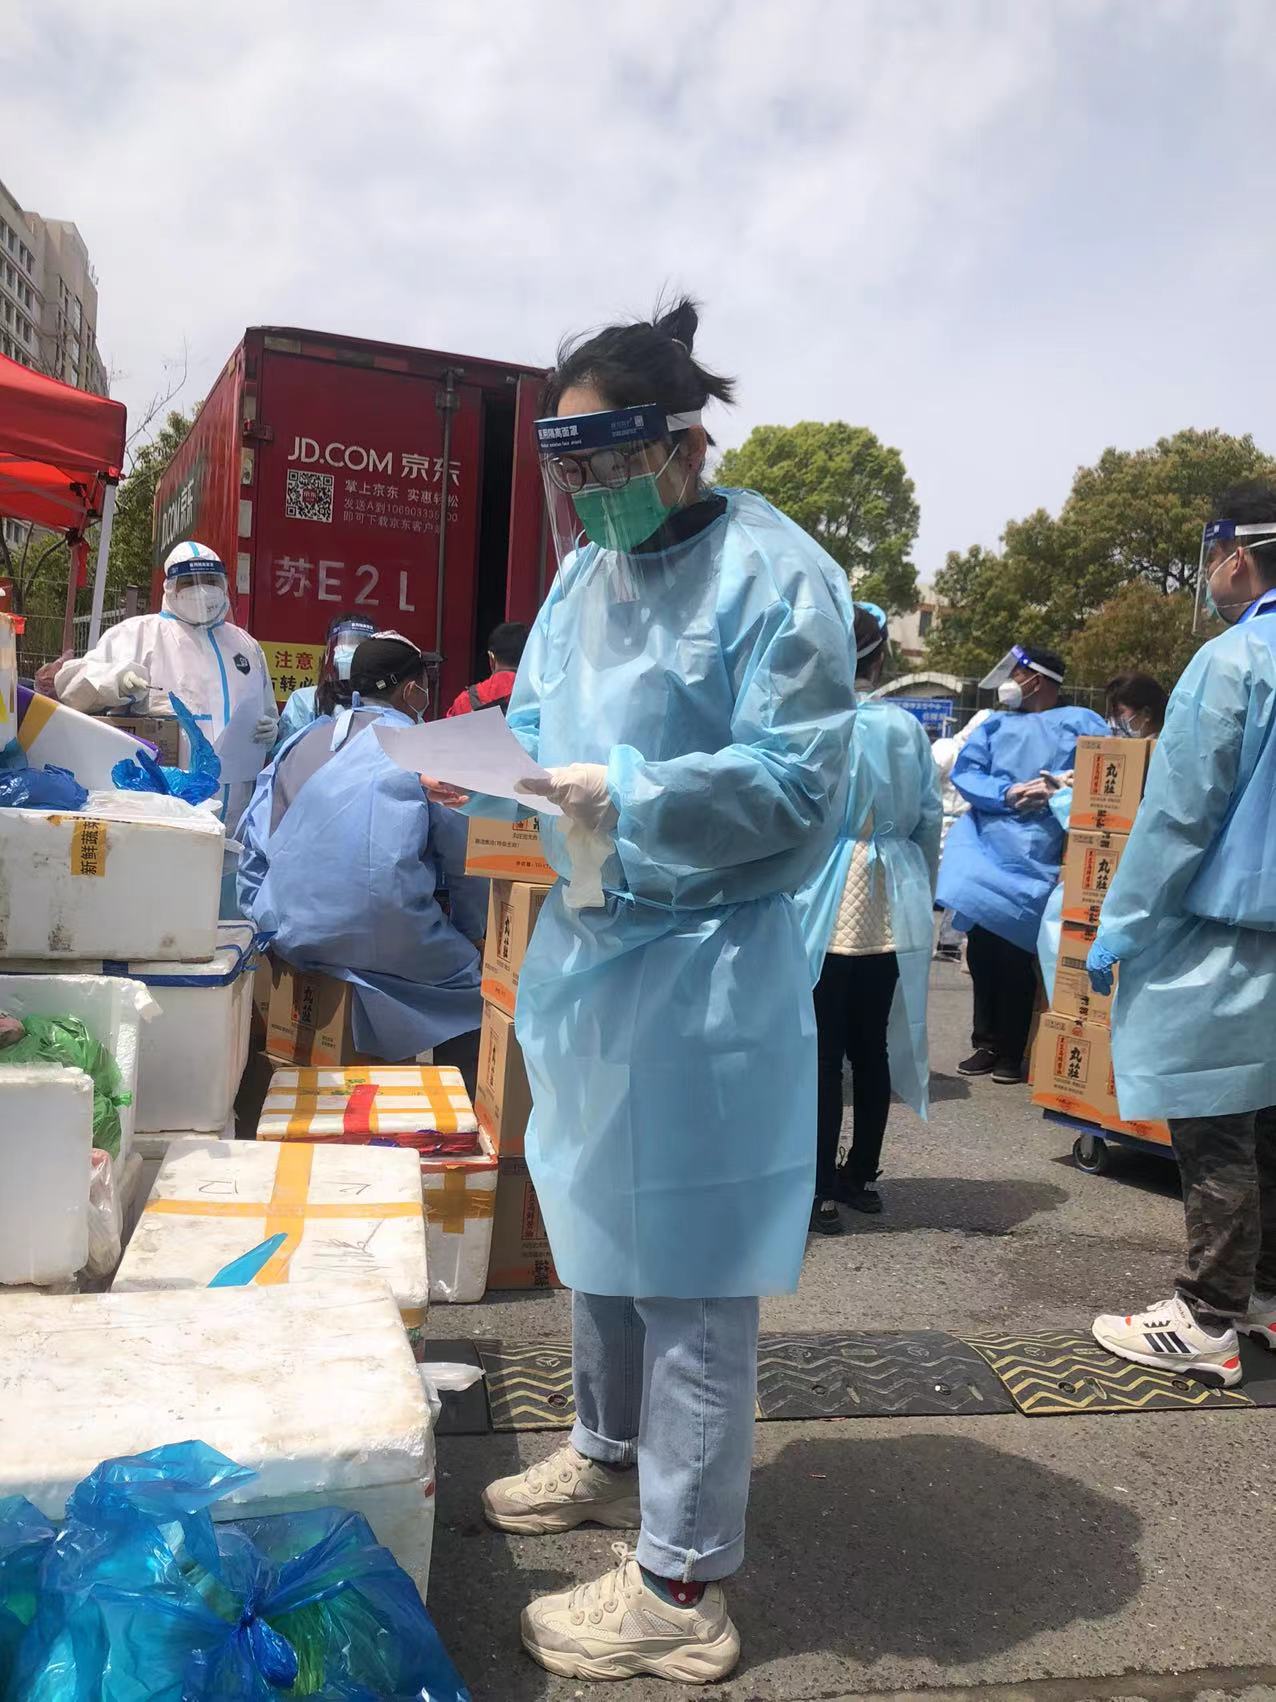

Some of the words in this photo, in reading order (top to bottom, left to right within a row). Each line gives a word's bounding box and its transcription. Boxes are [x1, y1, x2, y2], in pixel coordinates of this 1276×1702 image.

[287, 436, 393, 475] JD.COM
[401, 453, 462, 487] 京东
[345, 479, 399, 499] 掌上京东
[407, 488, 459, 507] 实惠轻松
[275, 650, 313, 670] 注意
